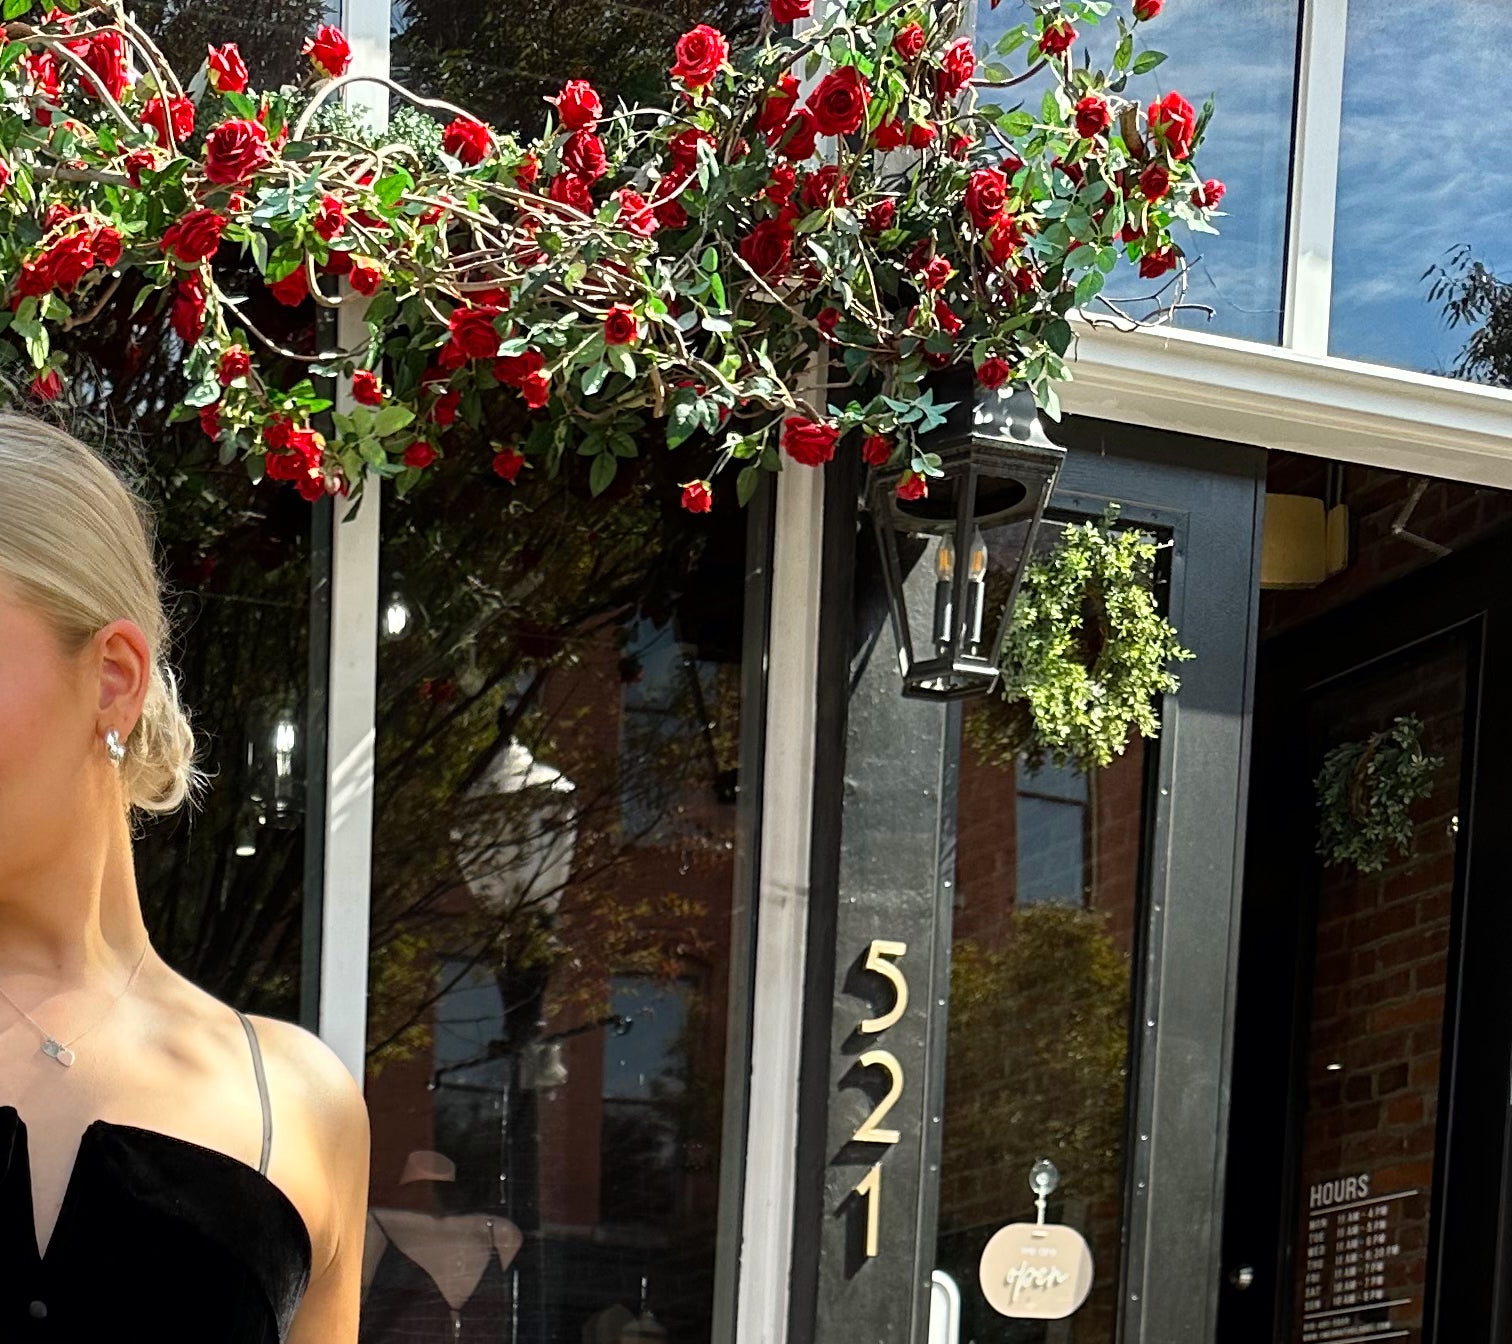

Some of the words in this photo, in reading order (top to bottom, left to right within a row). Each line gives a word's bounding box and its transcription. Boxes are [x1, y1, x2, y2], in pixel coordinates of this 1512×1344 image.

[852, 939, 908, 1257] 521
[1310, 1174, 1369, 1208] HOURS
[1006, 1261, 1070, 1303] open
